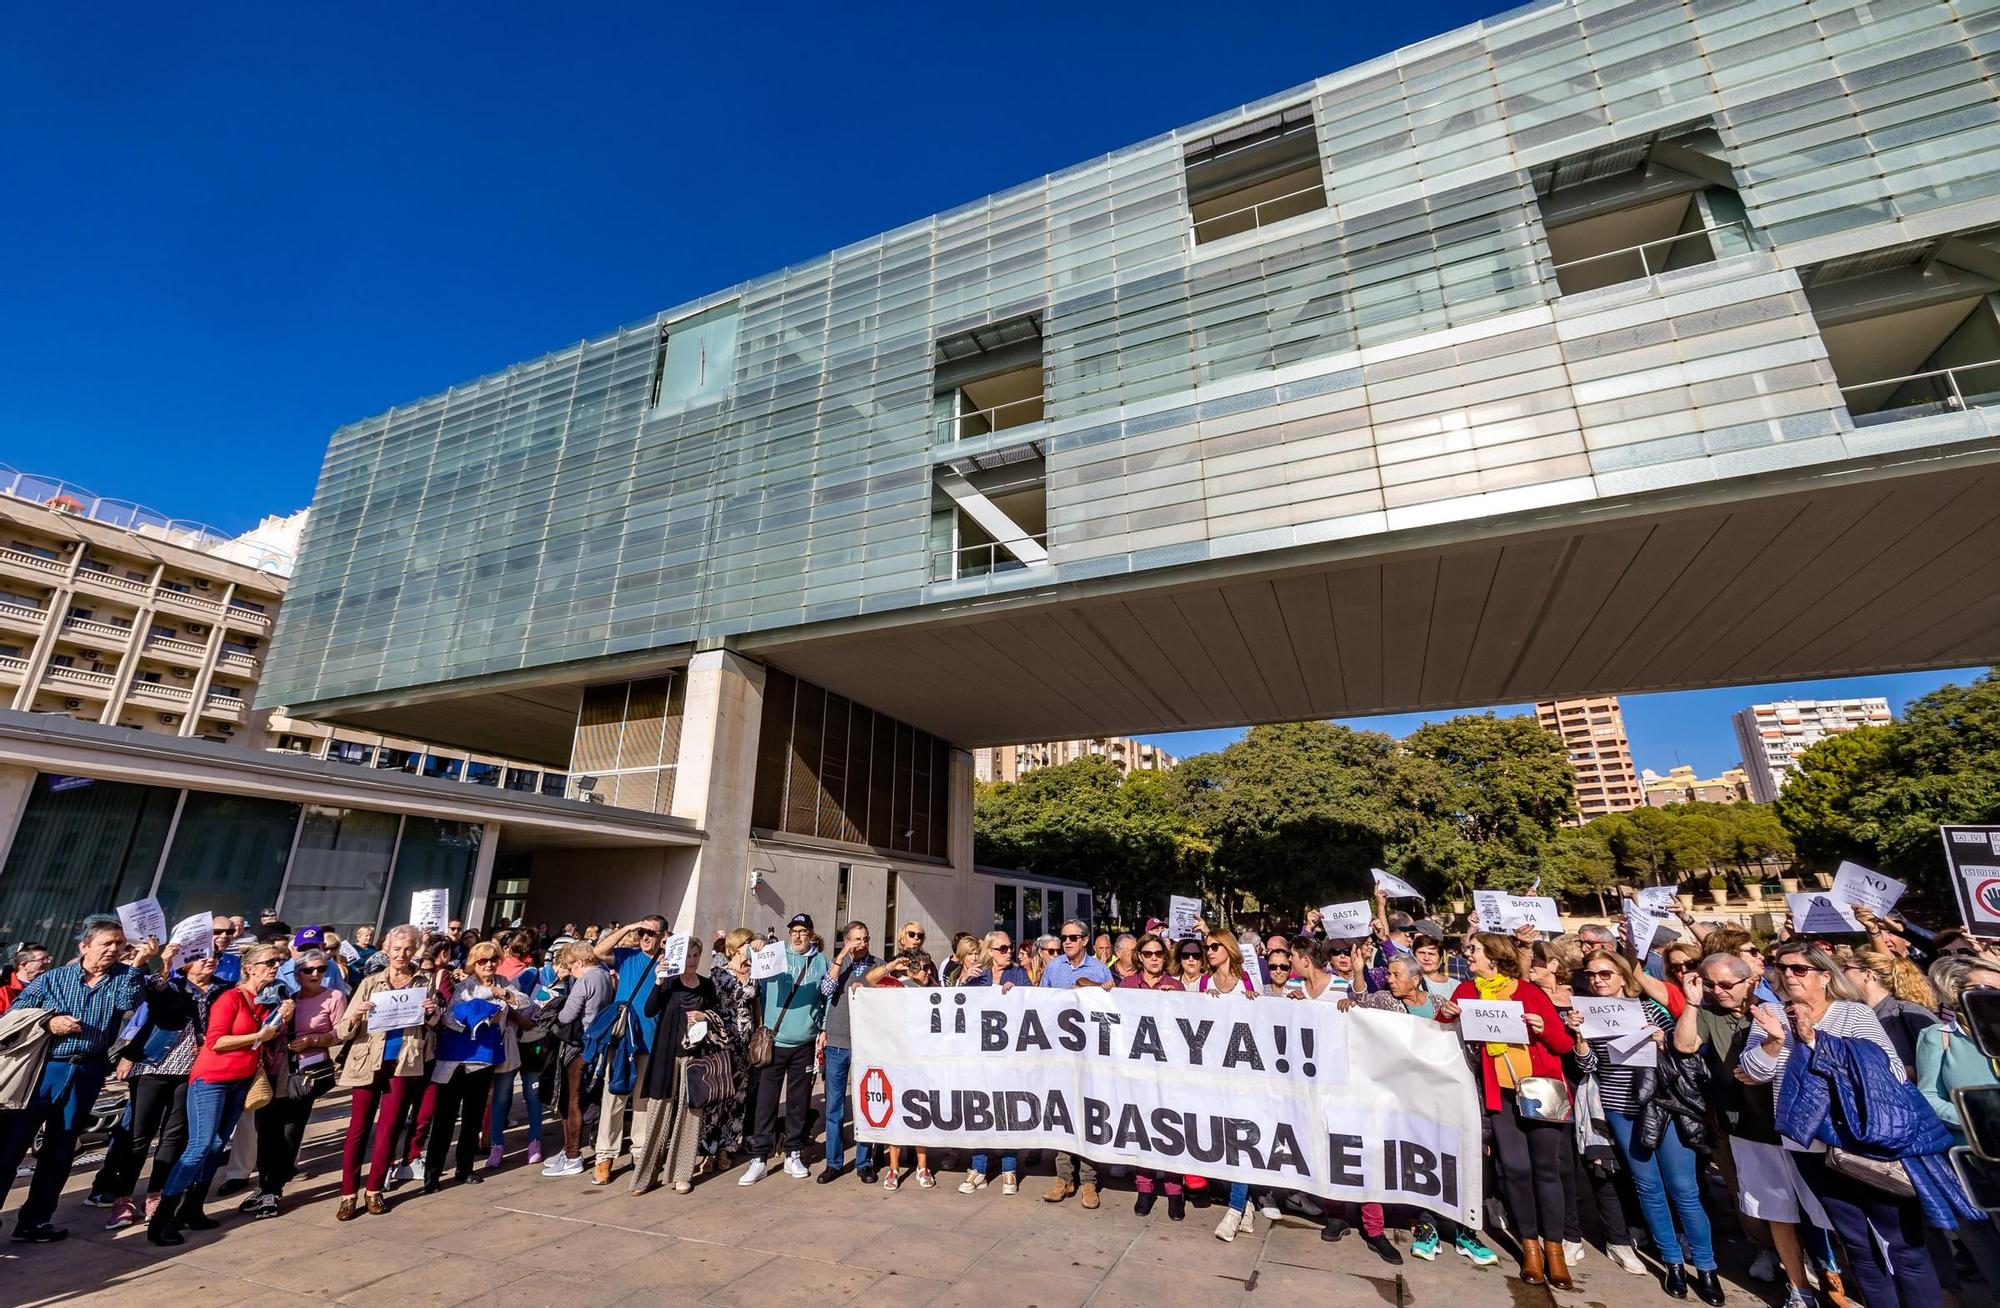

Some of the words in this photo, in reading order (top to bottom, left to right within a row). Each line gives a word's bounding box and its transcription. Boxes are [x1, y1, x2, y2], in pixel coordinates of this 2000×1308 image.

[1862, 875, 1887, 891] NO
[1511, 900, 1542, 909] BASTA
[1808, 898, 1832, 908] NO
[1332, 910, 1360, 920] BASTA
[1523, 913, 1537, 922] YA
[1343, 923, 1356, 931] YA
[761, 964, 771, 972] YA
[391, 994, 409, 1004] NO
[1475, 1009, 1509, 1019] BASTA
[1589, 1004, 1625, 1014] BASTA
[1487, 1024, 1501, 1034] YA
[1604, 1020, 1620, 1028] YA
[865, 1091, 887, 1104] STOP
[901, 1088, 1075, 1135] SUBIDA
[1084, 1097, 1311, 1177] BASURA
[1329, 1133, 1365, 1187] E
[1384, 1139, 1459, 1208] IBI
